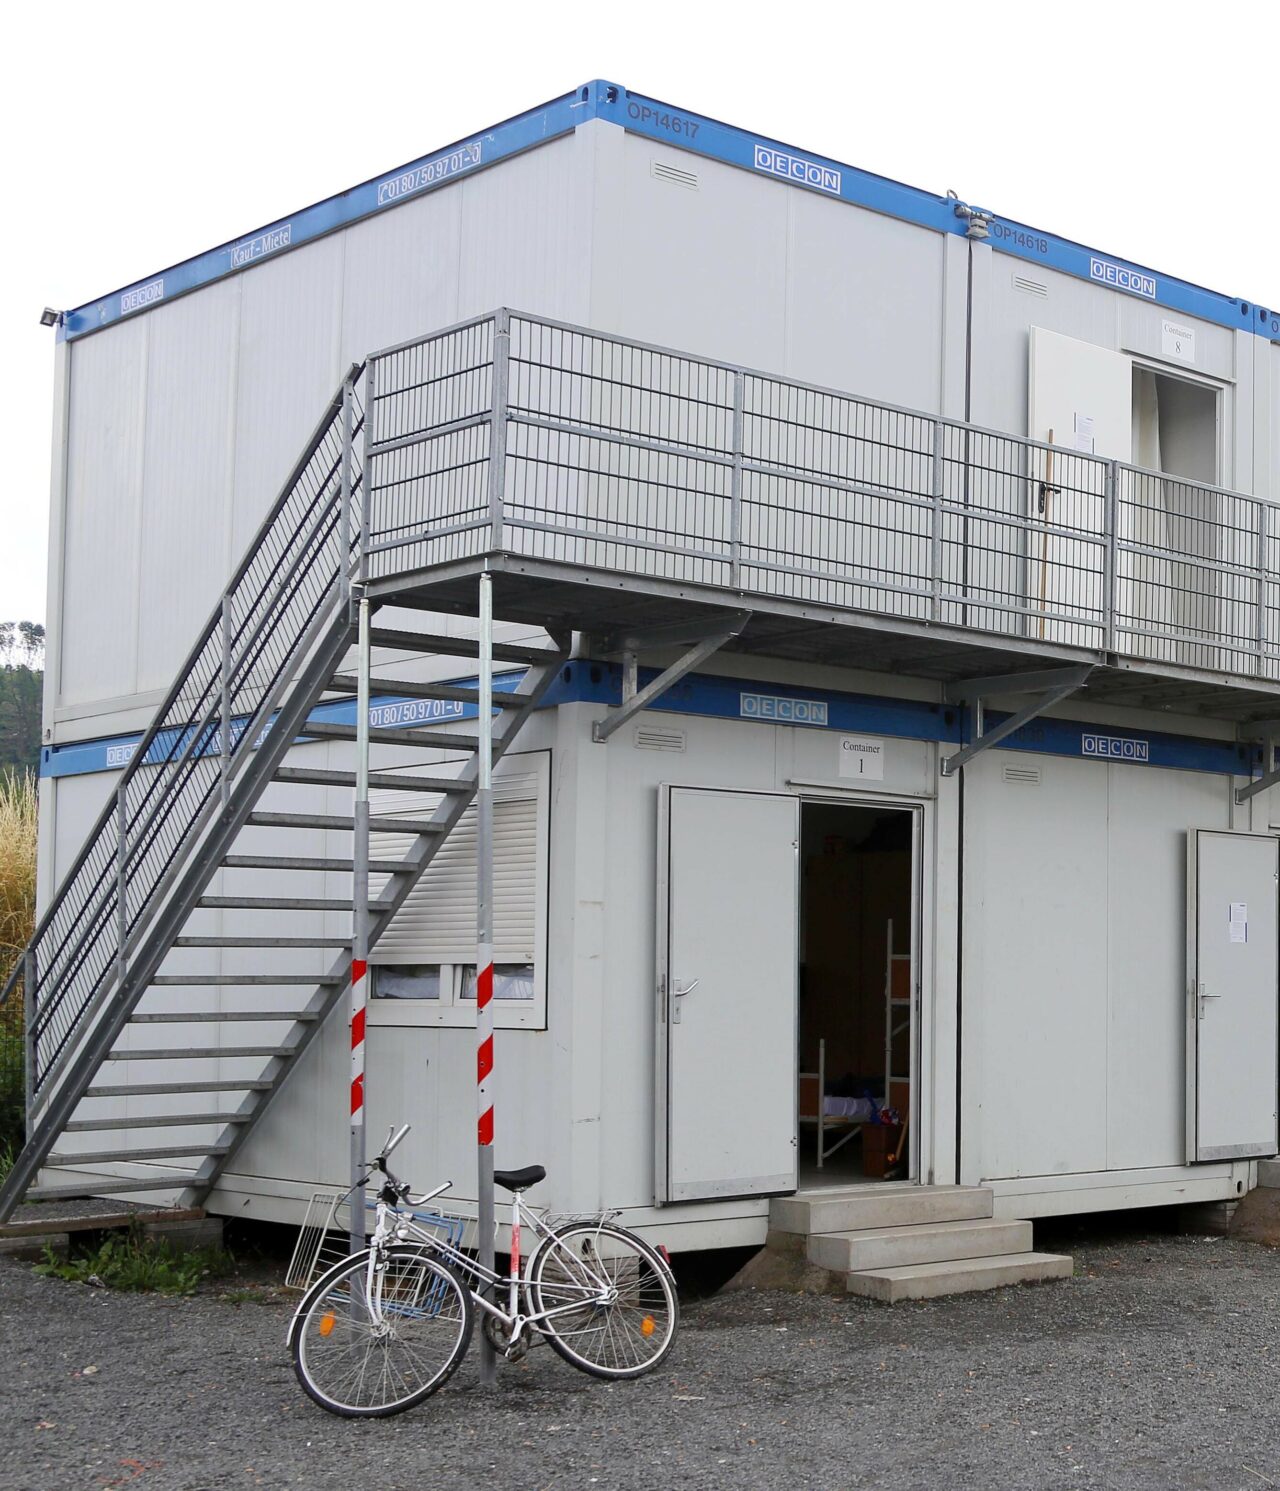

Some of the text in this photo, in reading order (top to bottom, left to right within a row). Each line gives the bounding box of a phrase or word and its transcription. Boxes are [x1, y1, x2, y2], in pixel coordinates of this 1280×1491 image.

[628, 102, 700, 138] OP14617
[757, 149, 838, 190] OECON
[993, 224, 1048, 254] OP14618
[1092, 261, 1154, 295] OECON
[122, 282, 163, 312] OECON
[1164, 324, 1192, 340] Container
[1175, 341, 1181, 353] 8
[742, 695, 826, 722] OECON
[842, 740, 881, 754] Container
[1084, 737, 1147, 758] OECON
[859, 758, 864, 773] 1
